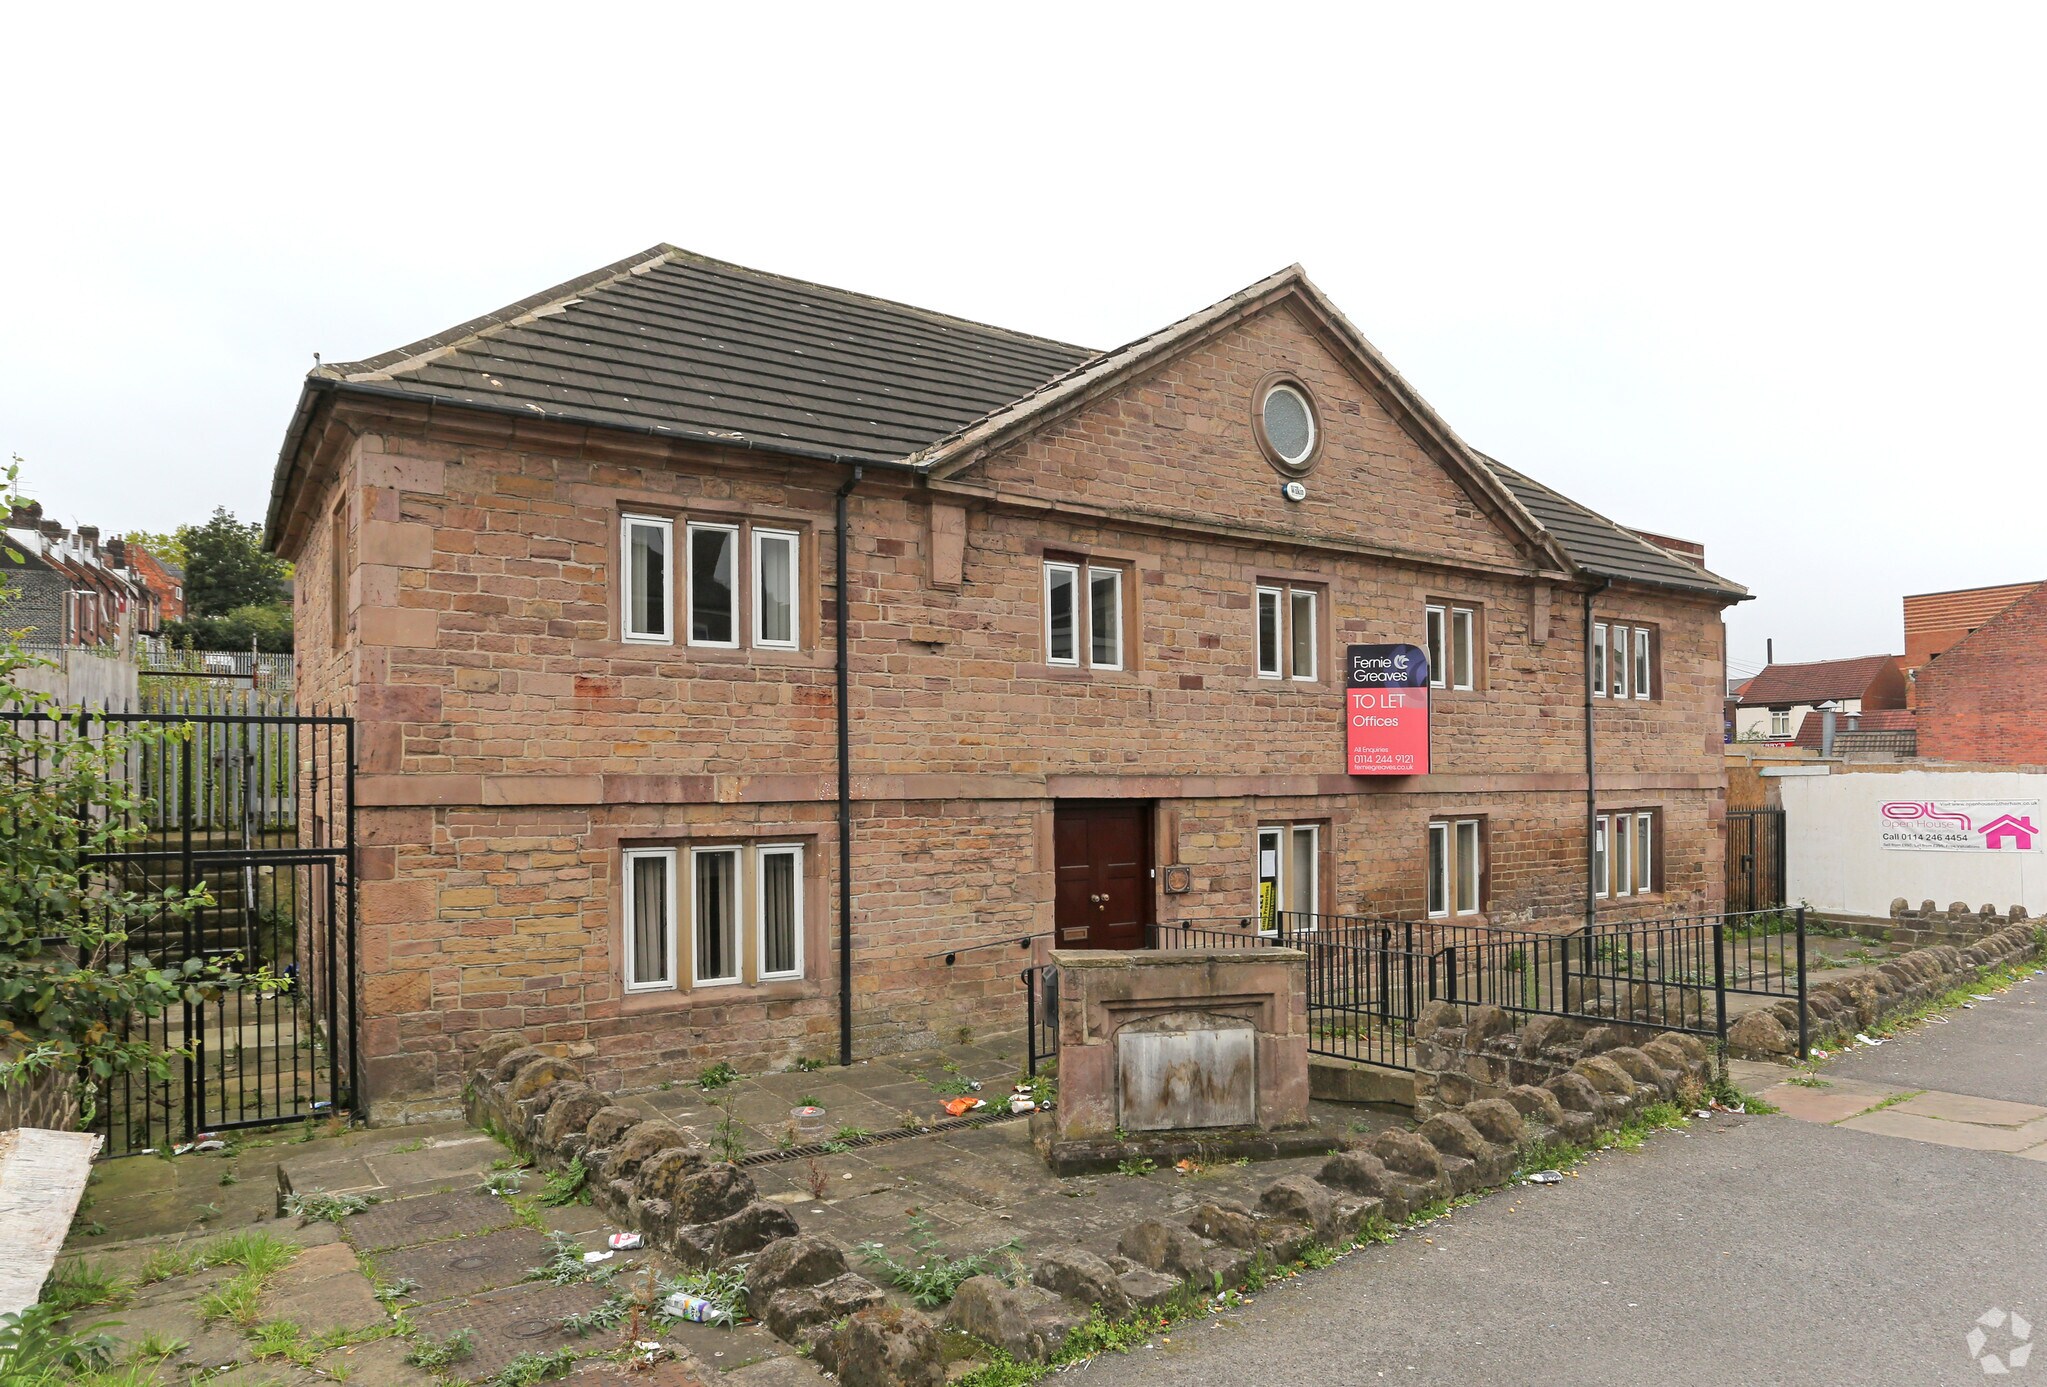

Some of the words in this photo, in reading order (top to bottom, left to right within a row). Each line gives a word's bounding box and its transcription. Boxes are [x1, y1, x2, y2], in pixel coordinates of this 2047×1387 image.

[1354, 656, 1391, 668] Fernie
[1354, 669, 1408, 682] Greaves
[1353, 694, 1376, 709] TO
[1381, 693, 1406, 709] LET
[1353, 715, 1399, 727] Offices
[1354, 755, 1372, 764] 0114
[1375, 755, 1393, 764] 244
[1395, 755, 1414, 763] 9121
[1882, 819, 1914, 829] Open
[1916, 820, 1954, 829] House
[1882, 832, 1900, 841] Call
[1901, 833, 1924, 841] 0114
[1925, 833, 1943, 841] 246
